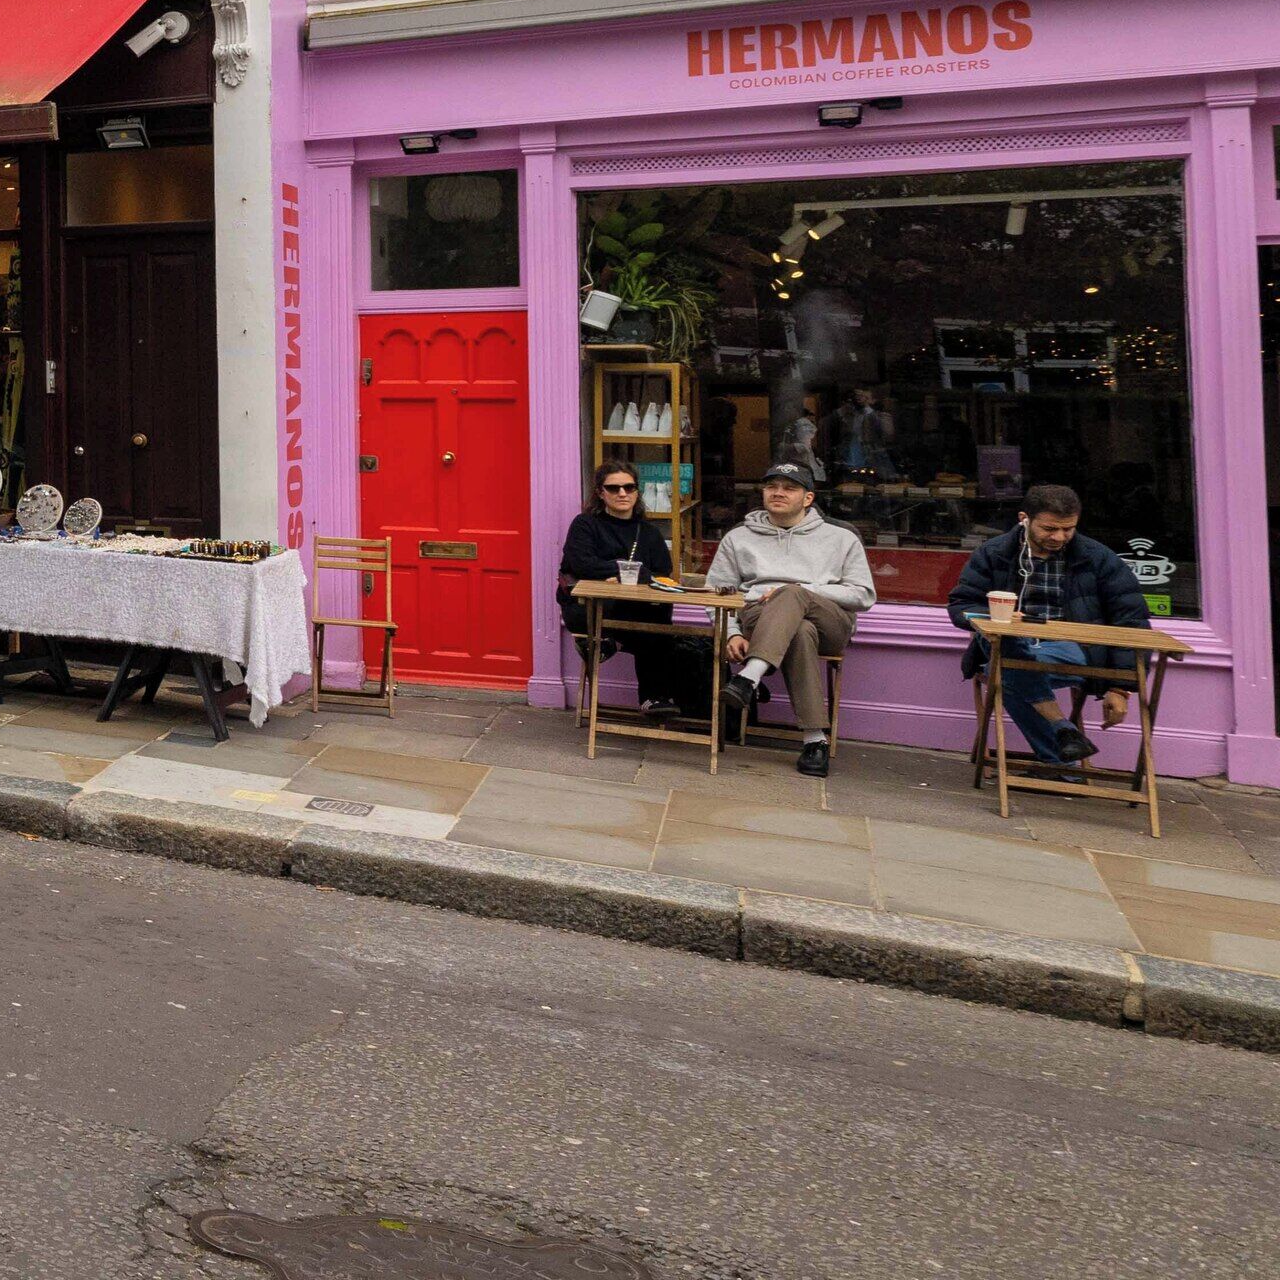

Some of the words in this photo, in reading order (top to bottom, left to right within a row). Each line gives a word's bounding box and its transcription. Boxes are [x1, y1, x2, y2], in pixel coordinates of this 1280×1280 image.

[686, 0, 1034, 78] HERMANOS
[729, 72, 827, 90] COLOMBIAN
[831, 66, 894, 81] COFFEE
[900, 58, 991, 76] ROASTERS
[282, 182, 305, 550] HERMANOS
